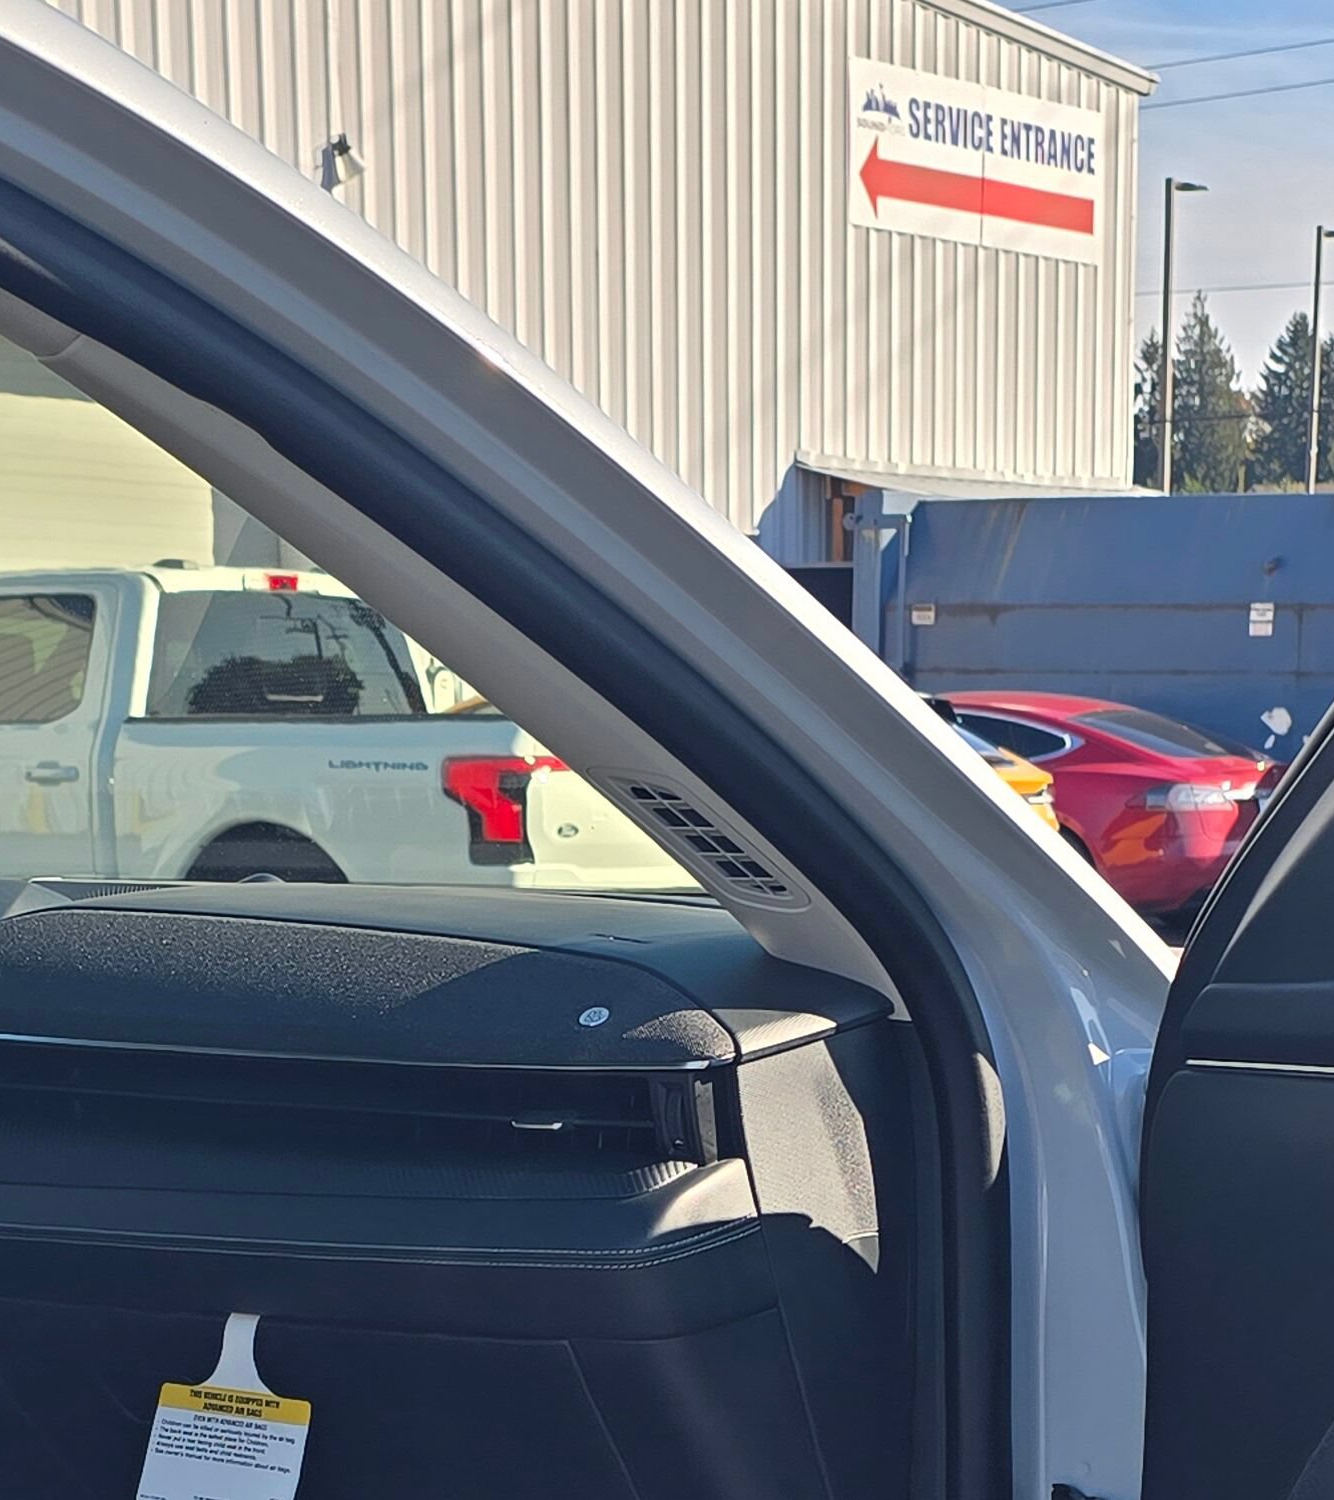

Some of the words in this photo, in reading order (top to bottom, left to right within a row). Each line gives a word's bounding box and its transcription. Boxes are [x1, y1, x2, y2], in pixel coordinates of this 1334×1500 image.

[908, 97, 993, 153] SERVICE
[999, 117, 1096, 175] ENTRANCE
[327, 759, 429, 773] LIGHTNING
